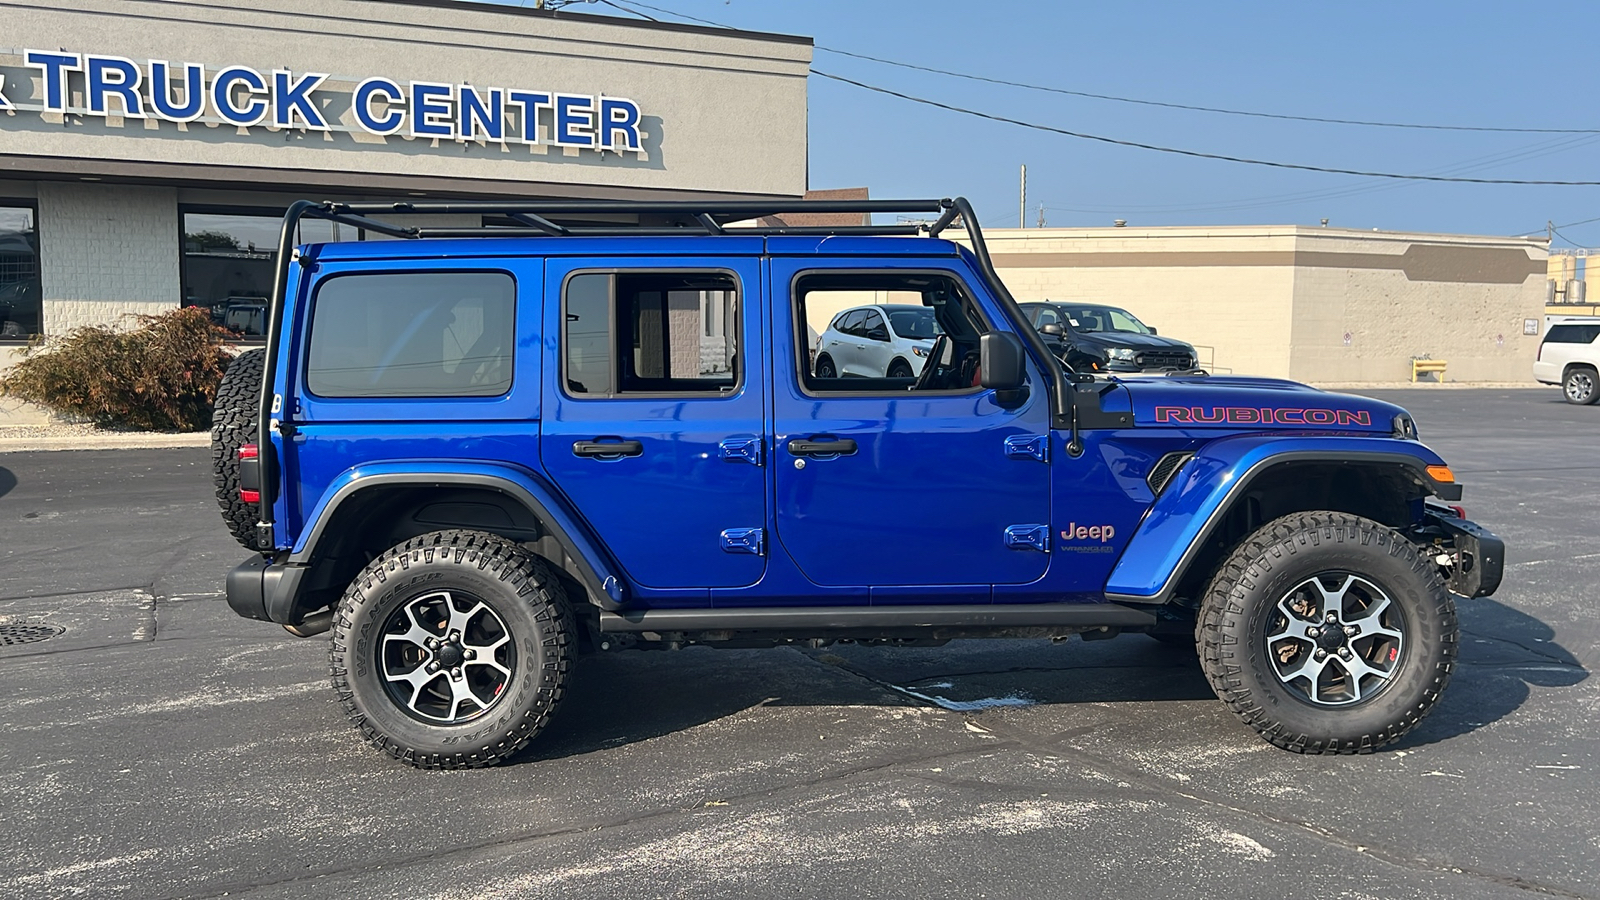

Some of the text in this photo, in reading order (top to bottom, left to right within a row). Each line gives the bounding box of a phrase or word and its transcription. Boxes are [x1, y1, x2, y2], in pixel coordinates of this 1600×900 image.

[24, 49, 331, 131] TRUCK
[352, 76, 645, 151] CENTER
[1155, 406, 1372, 426] RUBICON
[1061, 522, 1115, 542] Jeep
[357, 572, 444, 677] WRANGLER
[1387, 574, 1432, 715] GOODYEAR
[442, 637, 534, 745] GOODYEAR
